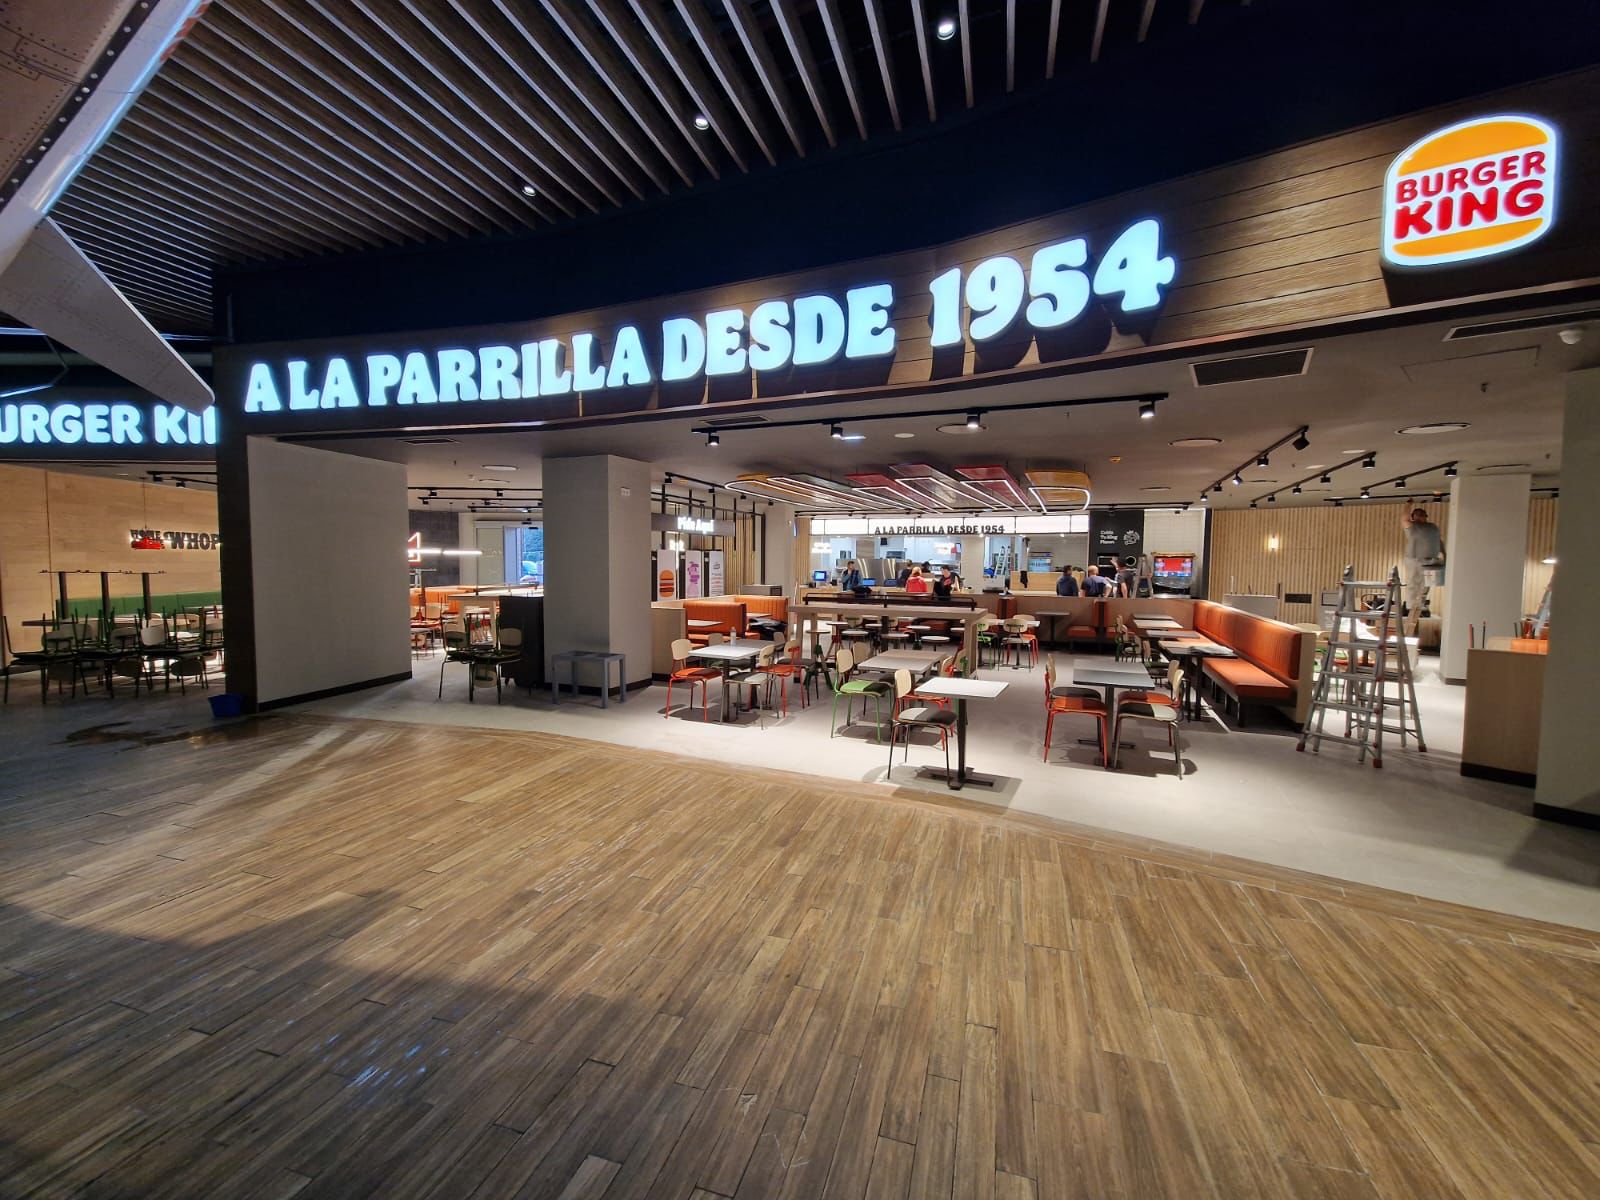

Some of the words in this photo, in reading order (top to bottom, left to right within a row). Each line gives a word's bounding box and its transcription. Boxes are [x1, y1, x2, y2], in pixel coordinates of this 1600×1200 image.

[1395, 151, 1546, 204] BURGER
[1394, 179, 1544, 239] KING
[244, 363, 281, 413] A
[288, 357, 360, 411] LA
[366, 325, 652, 407] PARRILLA
[662, 284, 896, 382] DESDE
[930, 218, 1176, 348] 1954
[882, 526, 895, 535] LA
[896, 525, 945, 535] PARRILLA
[946, 525, 979, 535] DESDE
[980, 525, 1005, 534] 1954
